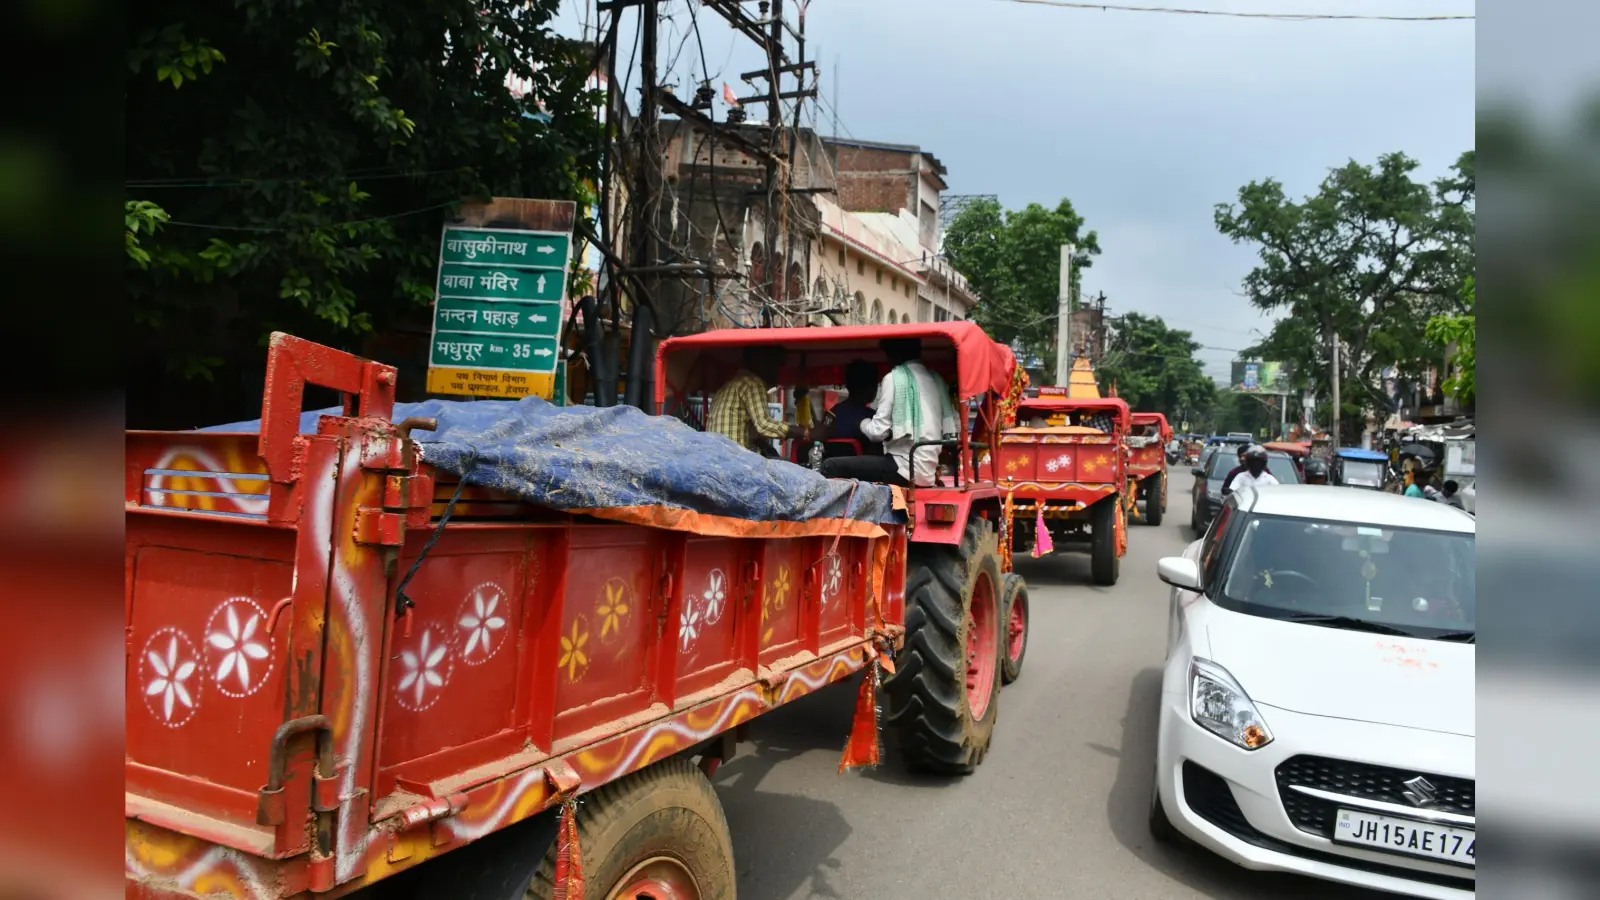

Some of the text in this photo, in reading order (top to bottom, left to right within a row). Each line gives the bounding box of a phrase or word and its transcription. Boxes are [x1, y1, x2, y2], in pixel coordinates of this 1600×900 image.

[447, 236, 528, 258] बासुकीनाथ
[443, 271, 519, 291] बाबा मंदिर
[440, 309, 520, 328] नन्दन पहाड़
[437, 341, 484, 361] मधुपूर
[512, 343, 530, 358] 35
[1352, 819, 1475, 859] JH15AE174
